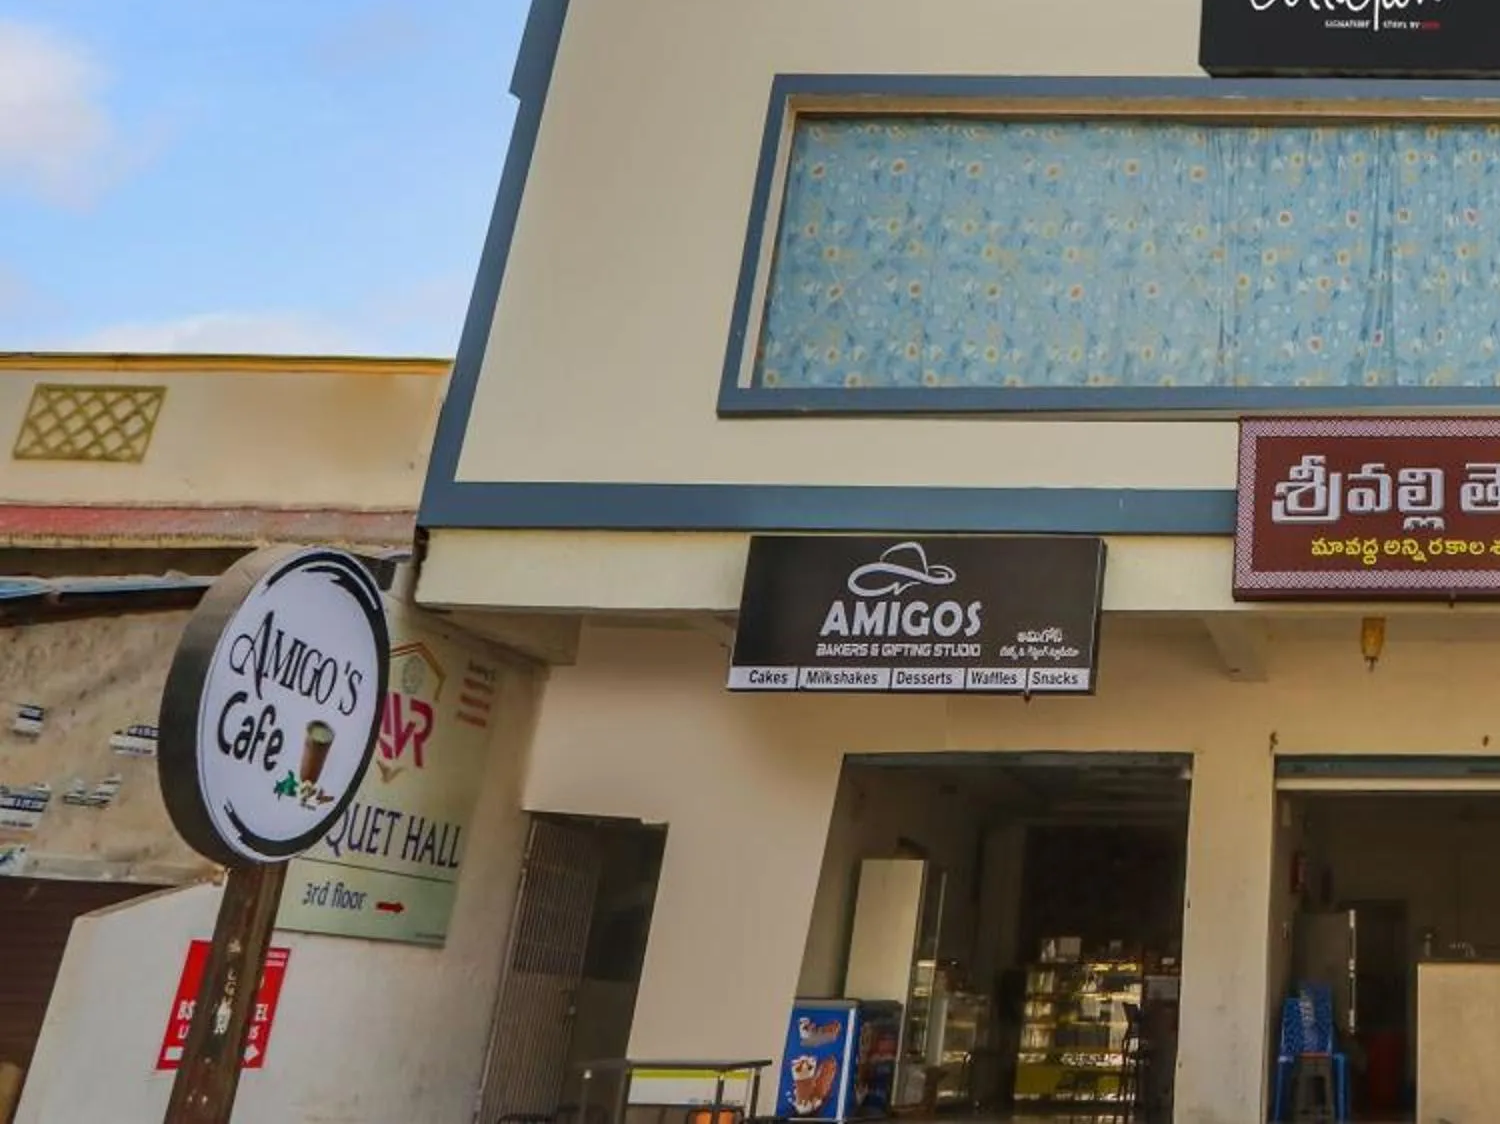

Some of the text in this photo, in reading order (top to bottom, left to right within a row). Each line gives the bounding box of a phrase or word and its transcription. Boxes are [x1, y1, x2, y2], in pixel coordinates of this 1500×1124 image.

[1272, 454, 1446, 531] శ్రీవల్లి
[819, 600, 982, 637] AMIGOS
[815, 643, 868, 657] BAKERS
[881, 643, 931, 657] GIFTING
[933, 643, 981, 657] STUDIO
[749, 669, 1078, 686] Cakes Milkshakes Desserts Waffles Snacks
[217, 691, 284, 771] Cafe
[401, 815, 462, 868] HALL
[301, 881, 368, 910] 3rd floor
